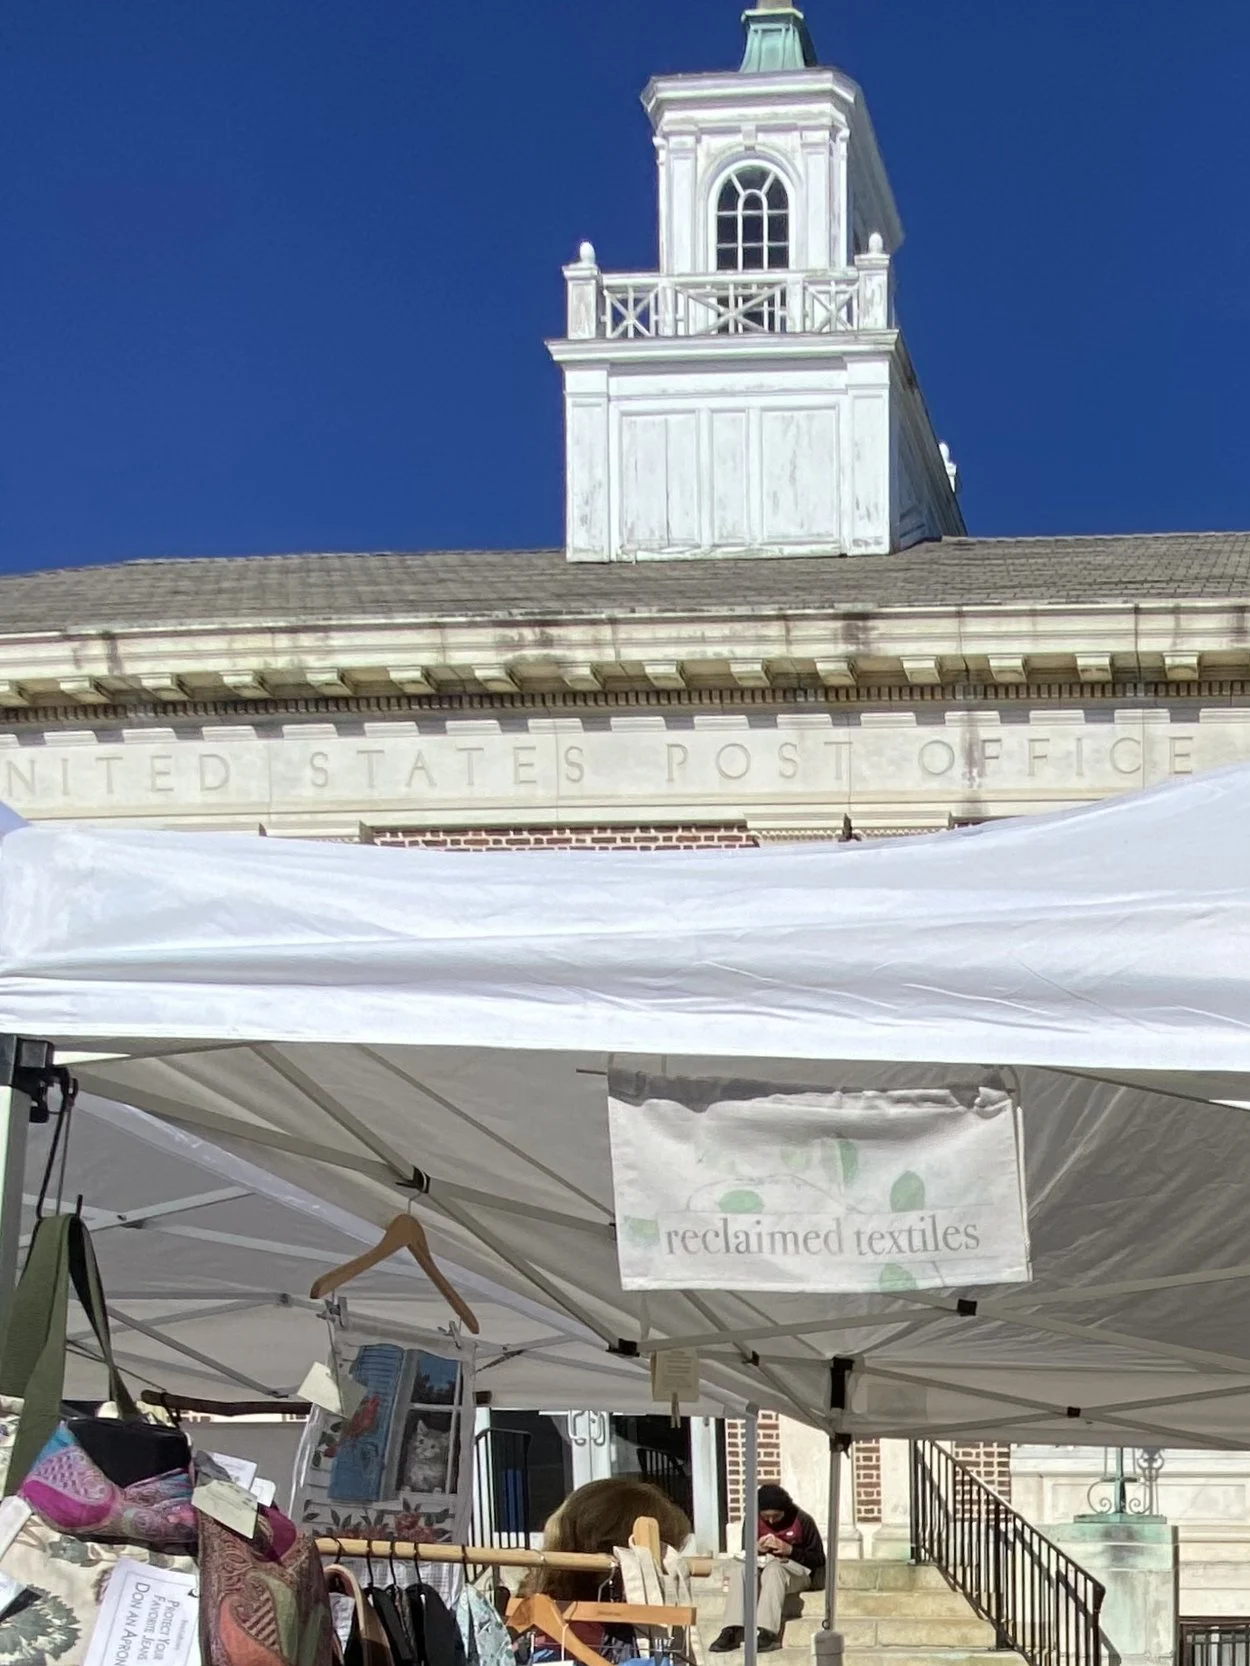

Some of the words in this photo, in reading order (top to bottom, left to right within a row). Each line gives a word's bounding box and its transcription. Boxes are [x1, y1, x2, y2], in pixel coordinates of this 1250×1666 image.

[3, 752, 232, 796] NITED
[309, 745, 586, 789] STATES
[665, 740, 852, 783] POST
[917, 736, 1194, 776] OFFICE
[664, 1217, 843, 1256] reclaimed
[855, 1215, 981, 1257] textiles
